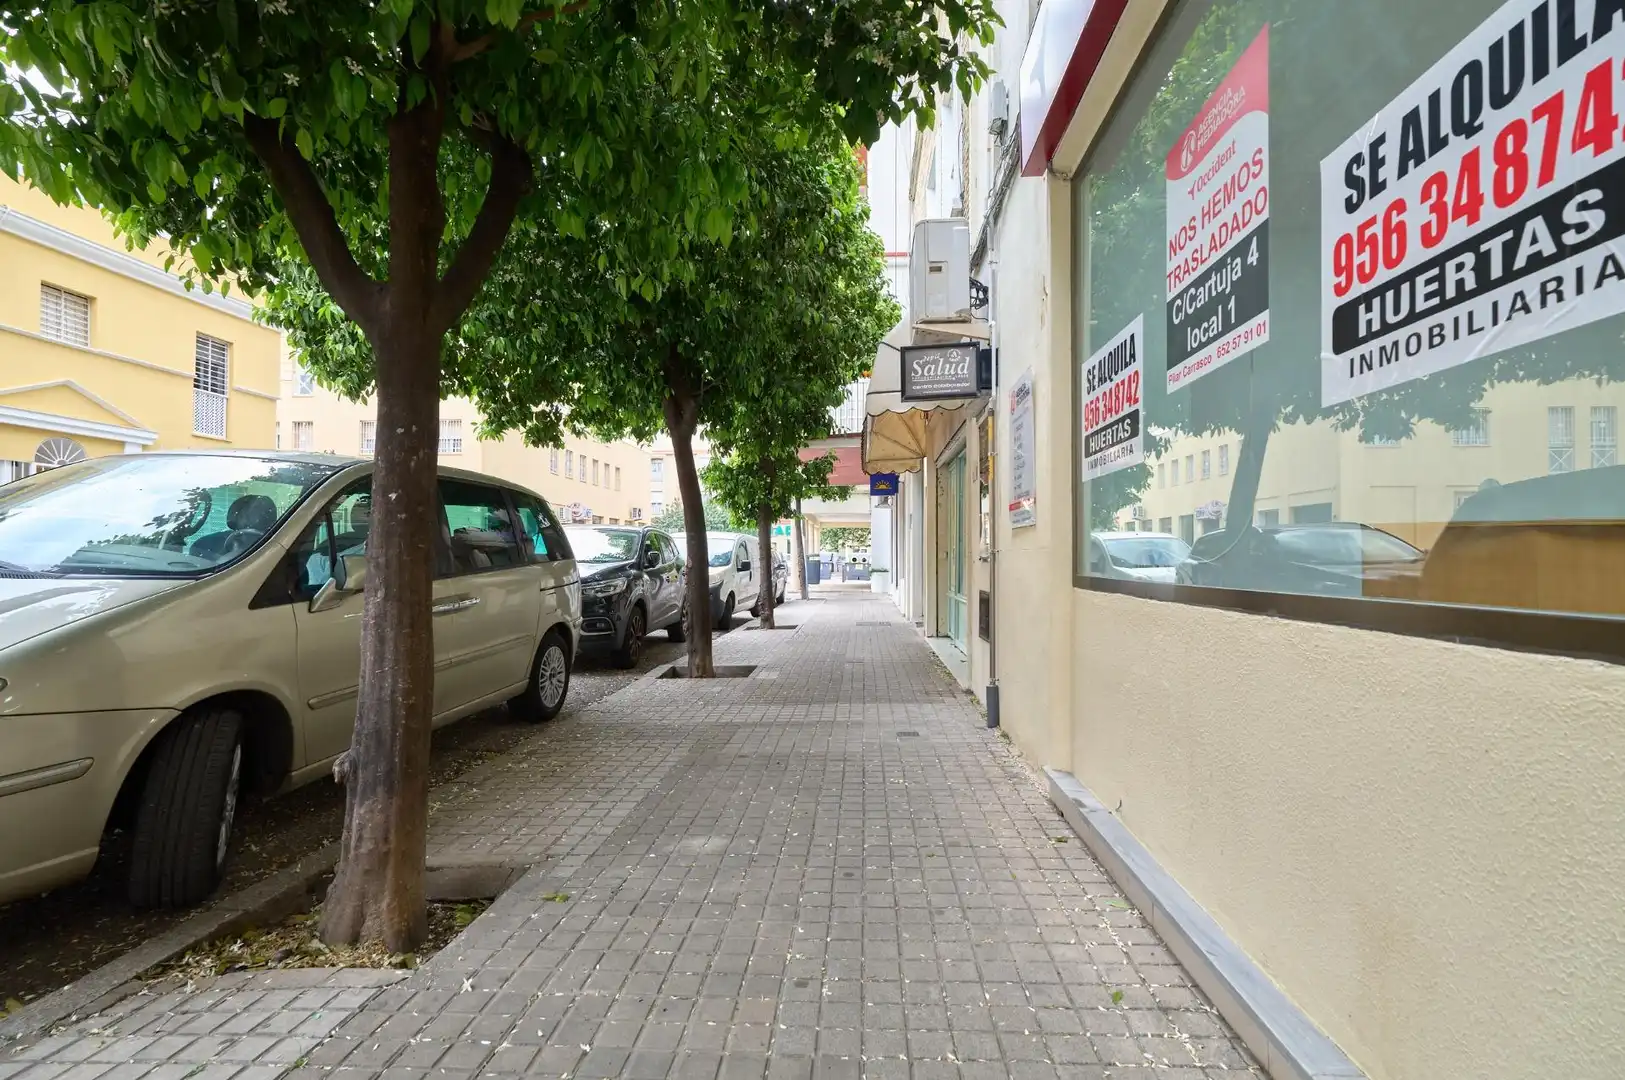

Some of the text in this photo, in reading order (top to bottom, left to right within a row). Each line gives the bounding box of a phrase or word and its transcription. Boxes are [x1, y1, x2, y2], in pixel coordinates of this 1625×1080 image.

[1197, 87, 1232, 135] AGENCIA
[1197, 86, 1246, 152] MEDIADORA
[1169, 147, 1263, 261] NOS HEMOS
[1333, 56, 1625, 297] 956 34874
[1344, 132, 1387, 214] SE
[1166, 186, 1268, 293] TRASLADADO
[1358, 188, 1606, 338] HUERTAS
[1173, 236, 1259, 325] C/Cartuja 4
[1187, 295, 1236, 351] local 1
[1349, 252, 1625, 378] INMOBILIARIA
[911, 356, 970, 376] Salud
[1086, 333, 1136, 395] SE ALQUILA
[1168, 320, 1266, 385] Pilar Carrasco 652 57 91 01
[1084, 396, 1100, 432] 956
[1101, 369, 1140, 422] 348742
[1087, 443, 1134, 471] INMOBILIARIA
[1089, 418, 1132, 453] HUERTAS
